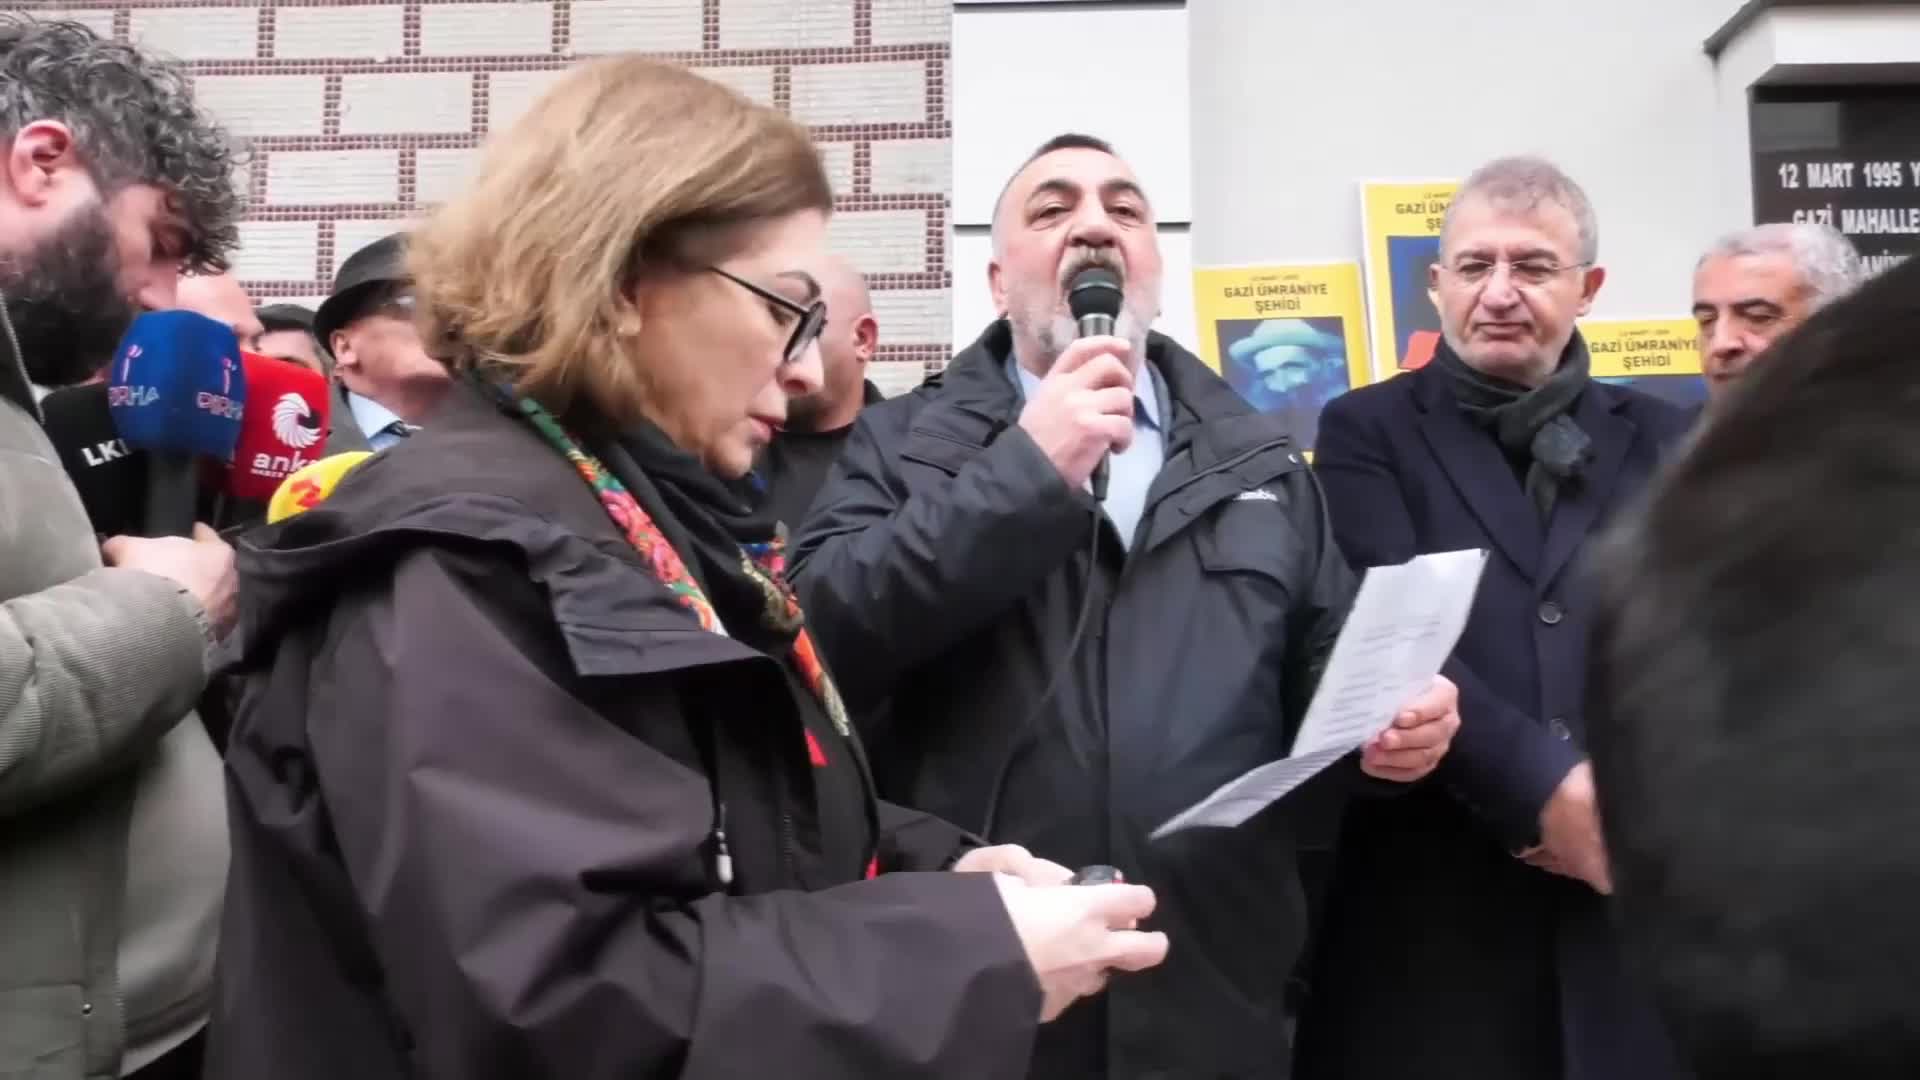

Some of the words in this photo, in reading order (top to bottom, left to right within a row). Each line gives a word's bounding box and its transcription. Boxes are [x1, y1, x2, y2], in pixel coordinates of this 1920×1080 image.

[1778, 163, 1799, 189] 12
[1806, 163, 1854, 188] MART
[1863, 162, 1902, 188] 1995
[1395, 202, 1425, 215] GAZİ
[1841, 208, 1920, 234] MAHALLE
[1224, 285, 1254, 298] GAZİ
[1257, 282, 1328, 297] ÜMRANİYE
[1255, 296, 1301, 315] ŞEHİDİ
[1590, 340, 1622, 353] GAZİ
[1623, 354, 1671, 371] ŞEHİDİ
[253, 450, 317, 472] ank
